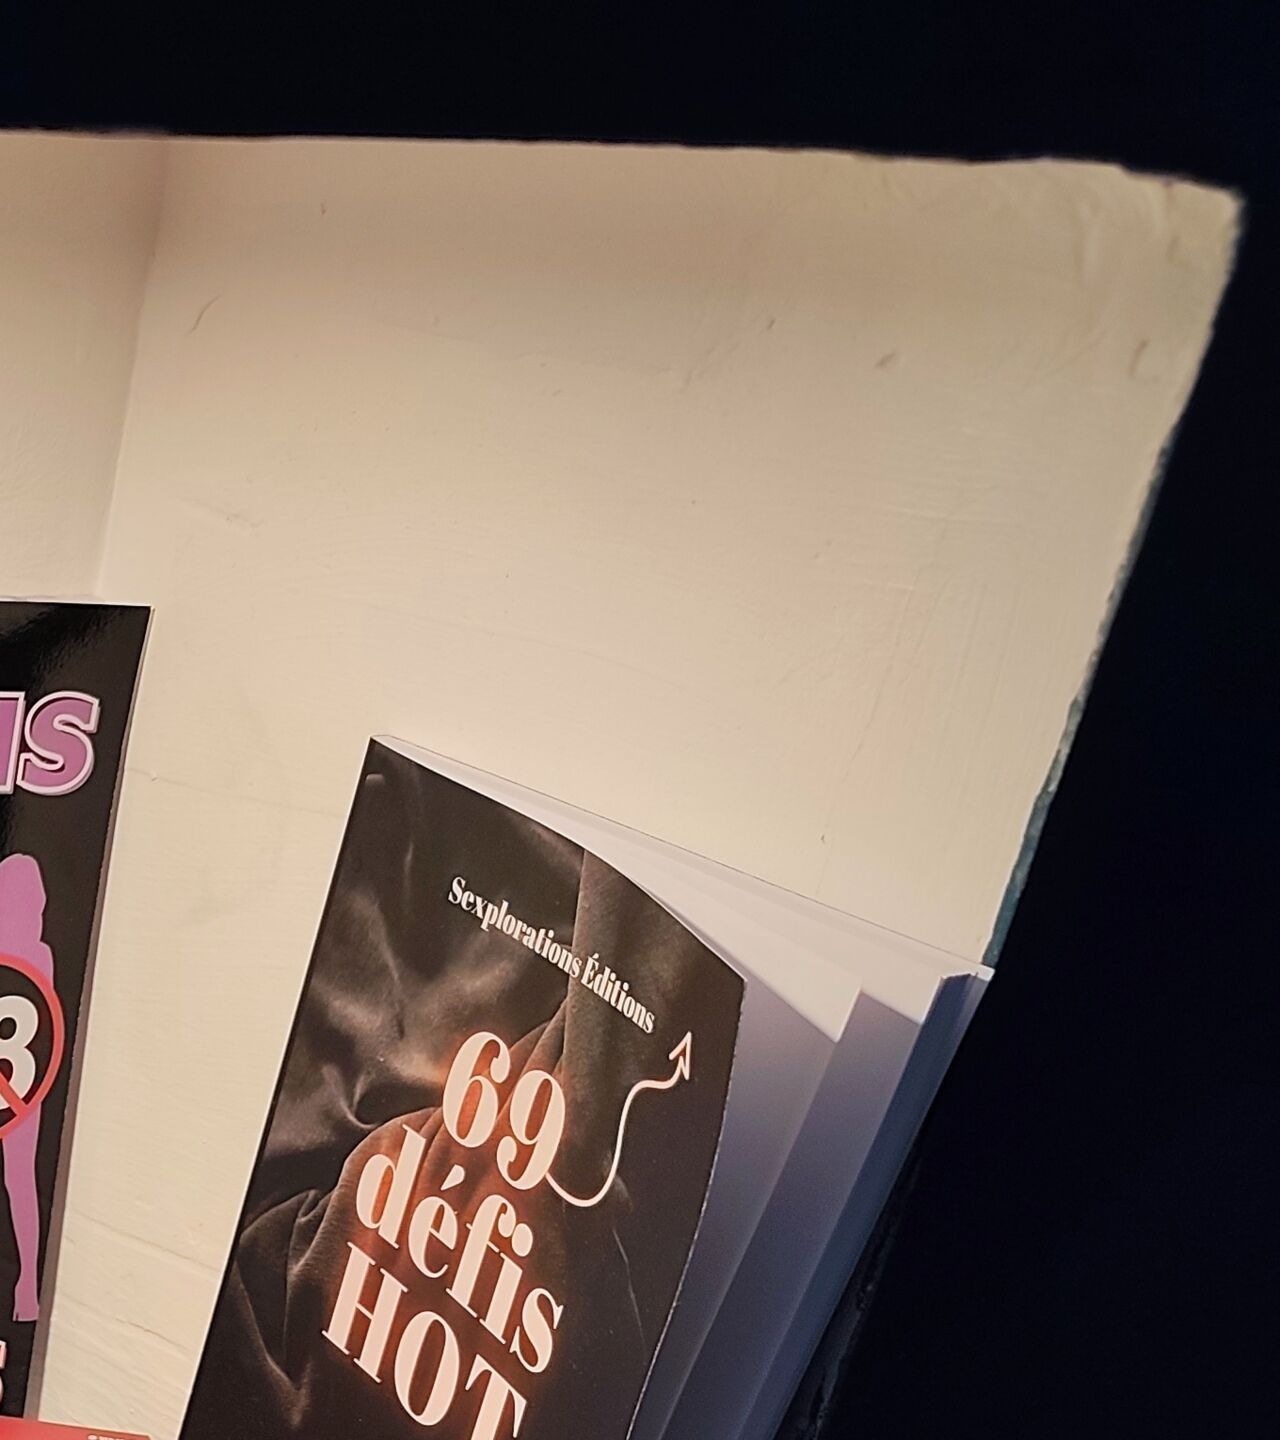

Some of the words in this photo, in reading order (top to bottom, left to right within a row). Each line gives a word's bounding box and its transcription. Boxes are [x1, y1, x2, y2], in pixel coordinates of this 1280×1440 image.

[447, 875, 582, 979] Sexplorations
[579, 952, 656, 1035] Éditions
[442, 1030, 566, 1190] 69
[355, 1122, 565, 1374] défis
